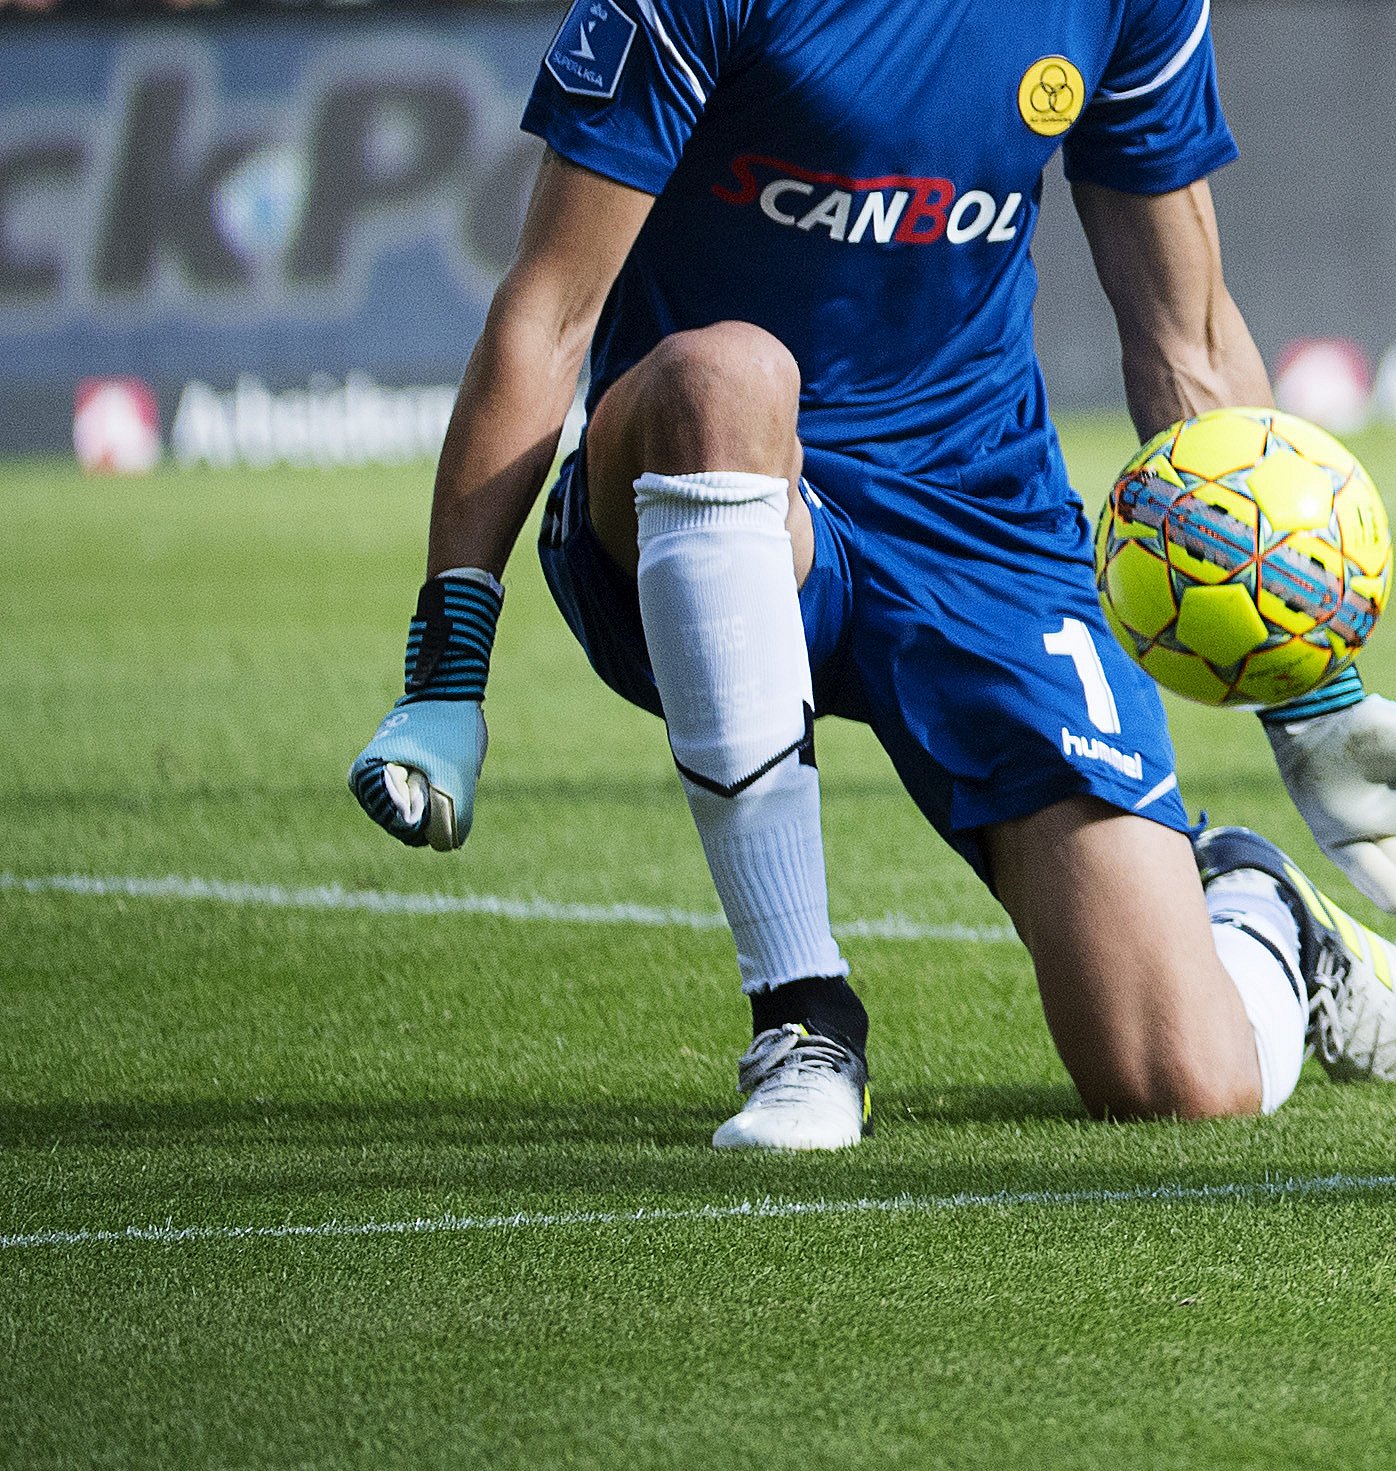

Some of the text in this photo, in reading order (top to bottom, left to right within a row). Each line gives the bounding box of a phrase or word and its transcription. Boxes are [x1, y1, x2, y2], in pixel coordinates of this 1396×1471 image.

[711, 155, 1022, 245] SCANBOL
[1043, 617, 1121, 735] 1
[1062, 727, 1143, 781] hummel
